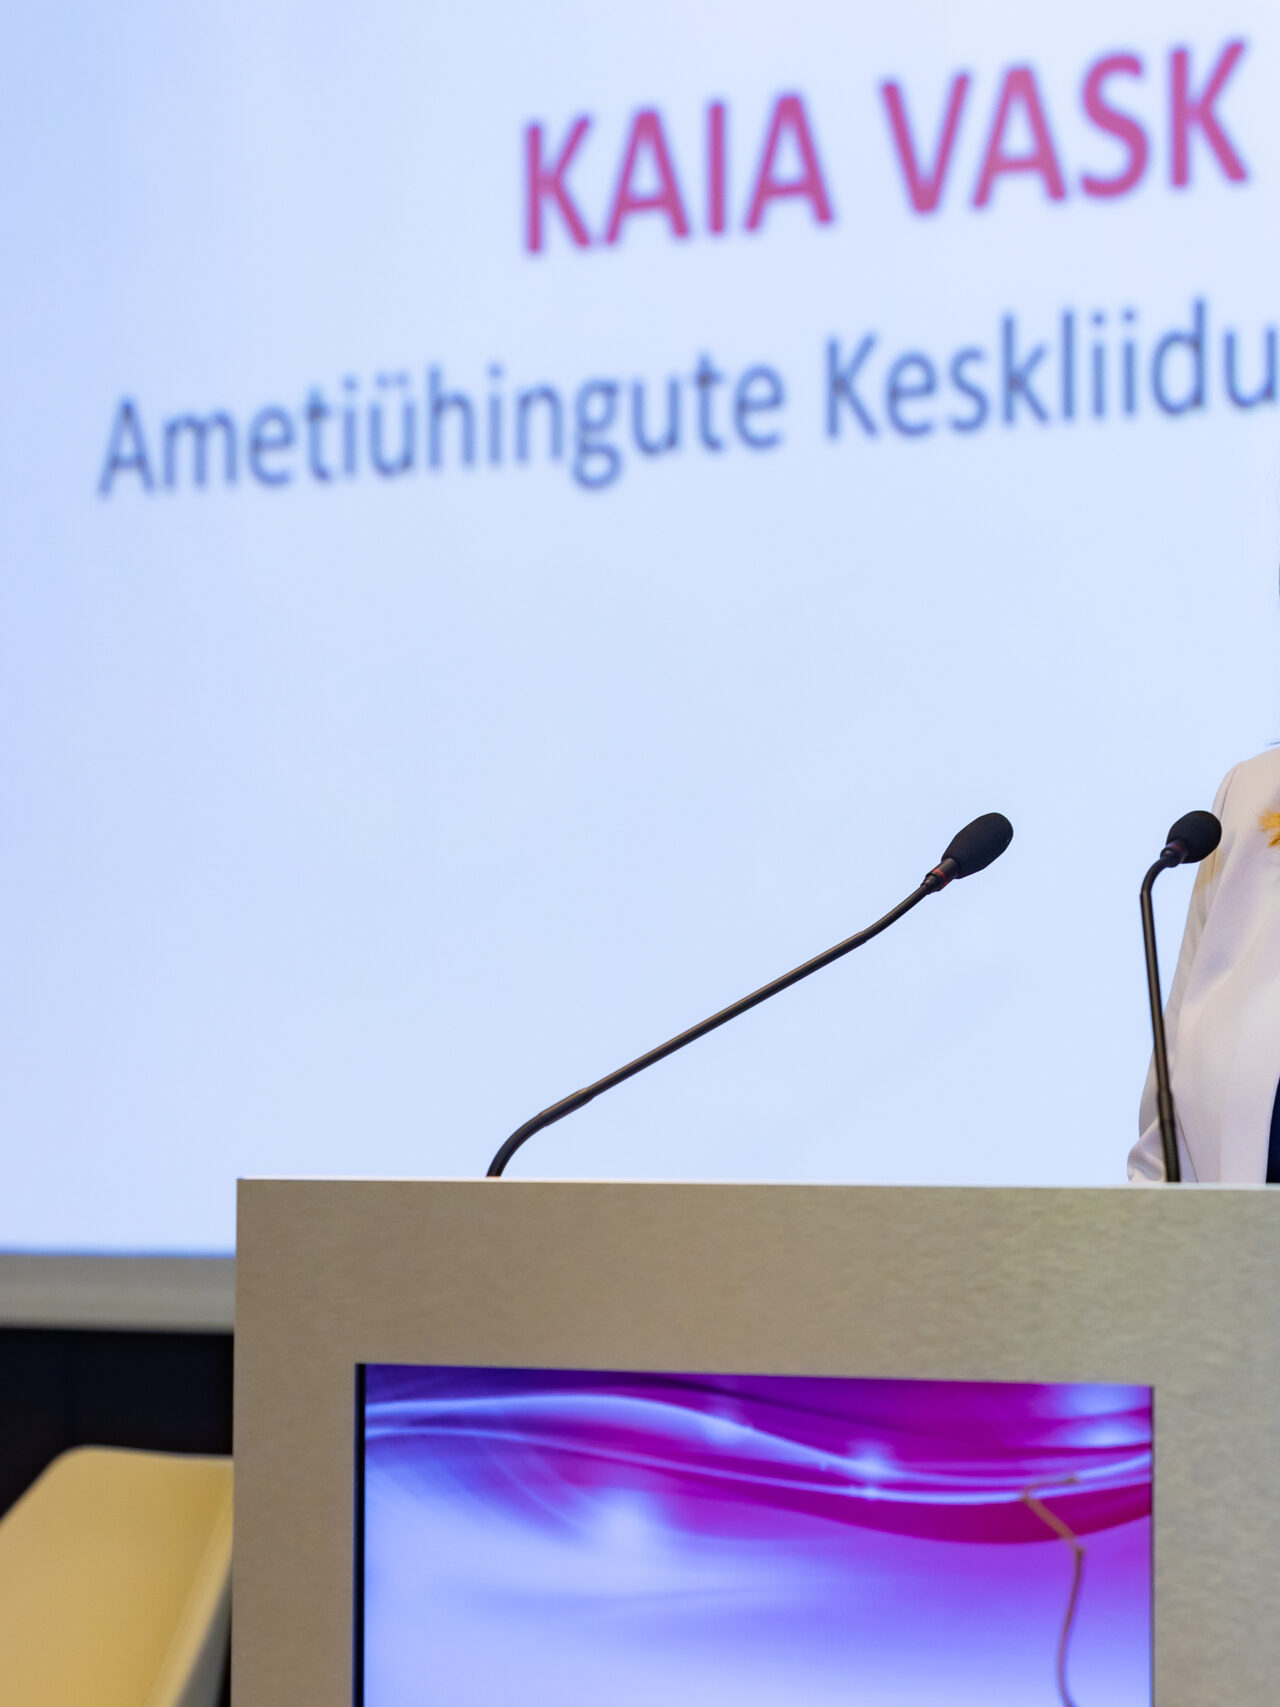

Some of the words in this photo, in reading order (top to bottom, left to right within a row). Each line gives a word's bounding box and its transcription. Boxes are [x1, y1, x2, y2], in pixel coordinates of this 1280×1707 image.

[522, 91, 836, 256] KAIA
[879, 38, 1250, 217] VASK
[99, 355, 786, 493] Ametiühingute
[826, 297, 1279, 439] Keskliidu
